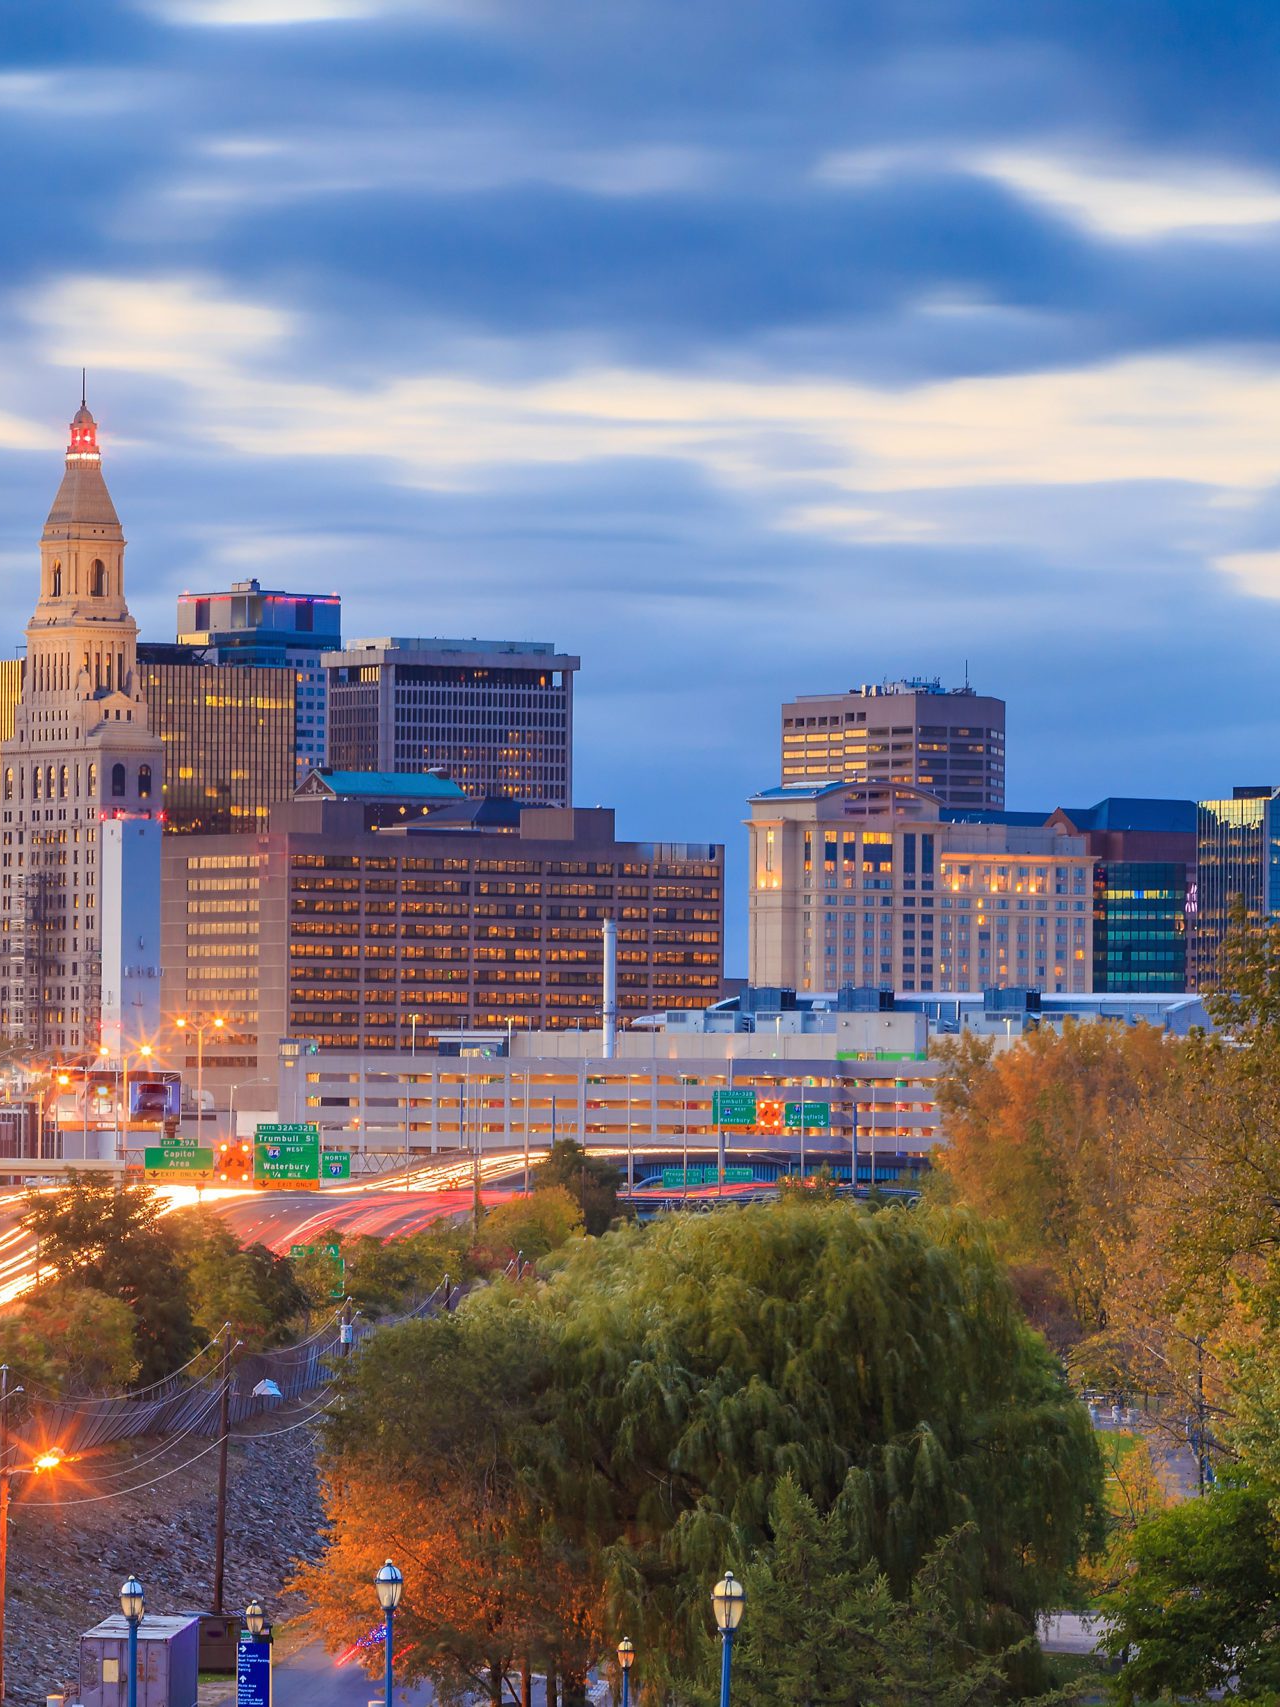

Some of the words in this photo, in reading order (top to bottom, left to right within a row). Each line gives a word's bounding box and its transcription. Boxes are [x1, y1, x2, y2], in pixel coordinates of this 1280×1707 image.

[277, 1124, 314, 1132] 32A-32B
[163, 1150, 195, 1158] Capitol
[263, 1163, 310, 1172] Waterbury
